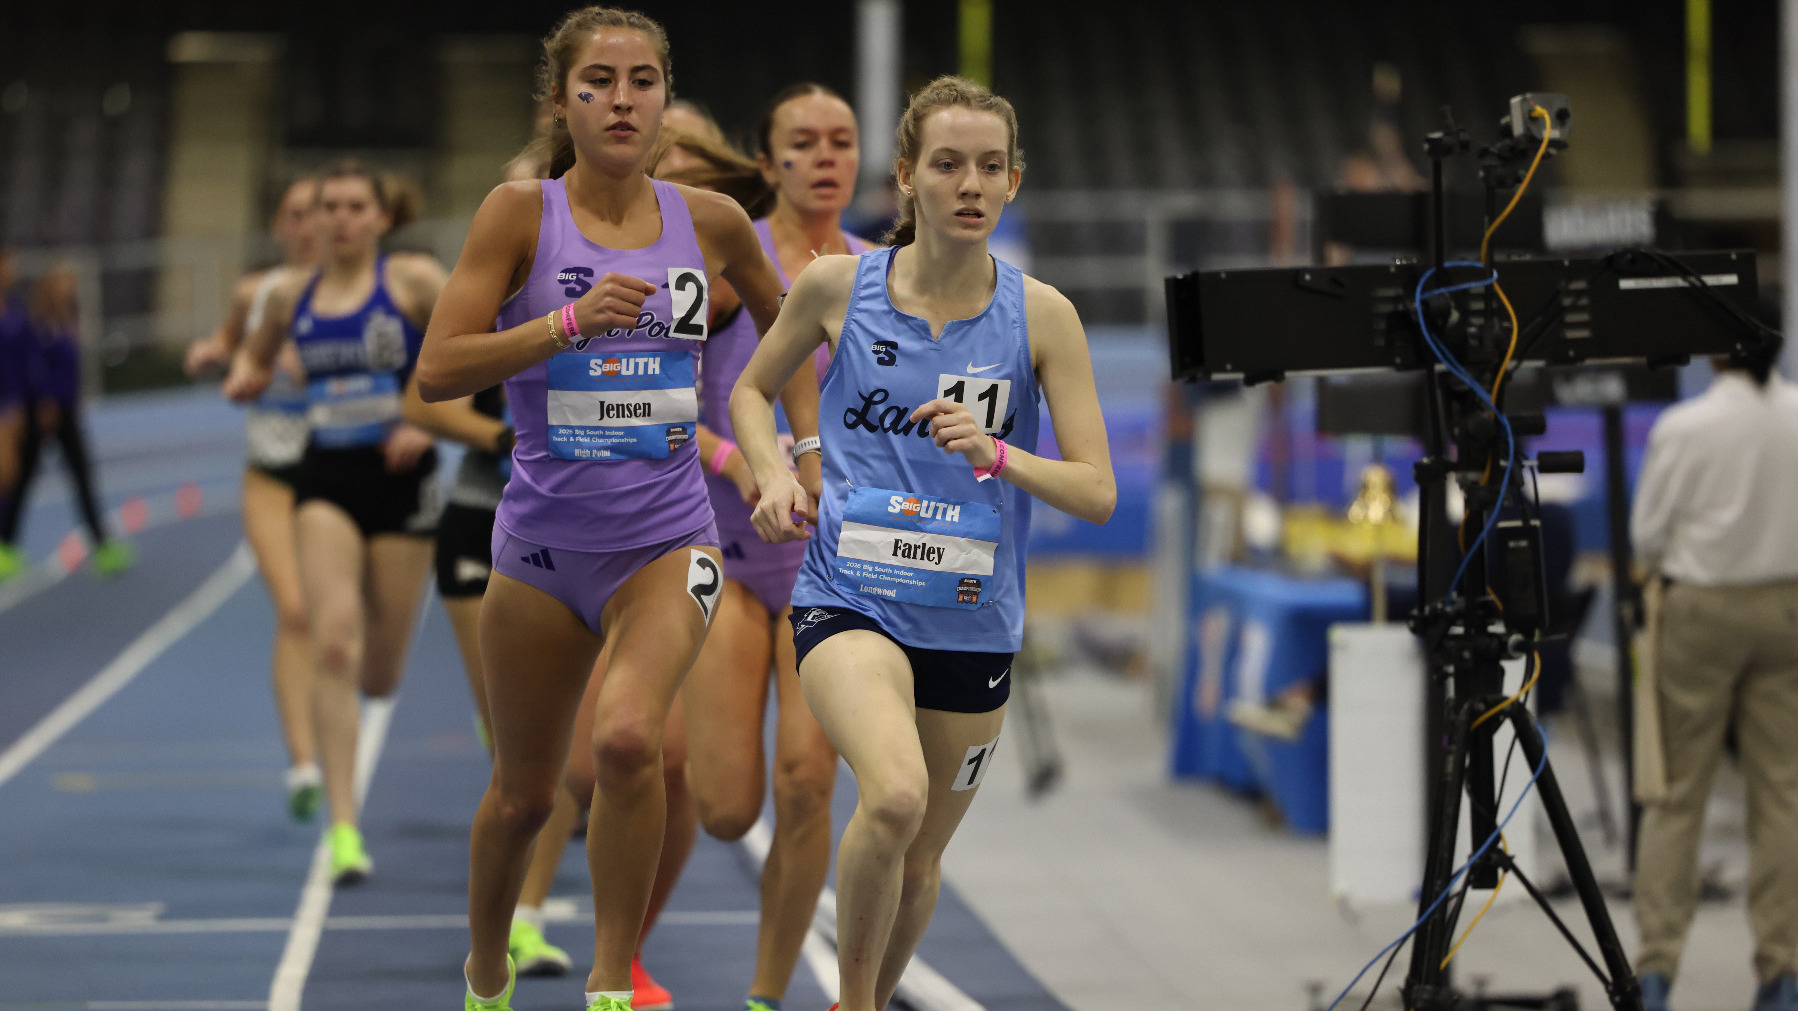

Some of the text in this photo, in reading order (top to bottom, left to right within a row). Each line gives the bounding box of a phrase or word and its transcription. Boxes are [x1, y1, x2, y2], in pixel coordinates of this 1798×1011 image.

[557, 272, 577, 281] BIG
[673, 271, 704, 336] 2
[871, 344, 886, 352] BIG
[598, 400, 651, 421] Jensen
[591, 436, 638, 444] Championships
[574, 449, 611, 457] High Point
[891, 538, 946, 566] Farley
[838, 567, 855, 576] Track
[878, 574, 926, 587] Championships
[874, 565, 893, 574] South
[893, 569, 914, 577] Indoor
[690, 557, 719, 619] 2
[859, 584, 897, 598] Longwood
